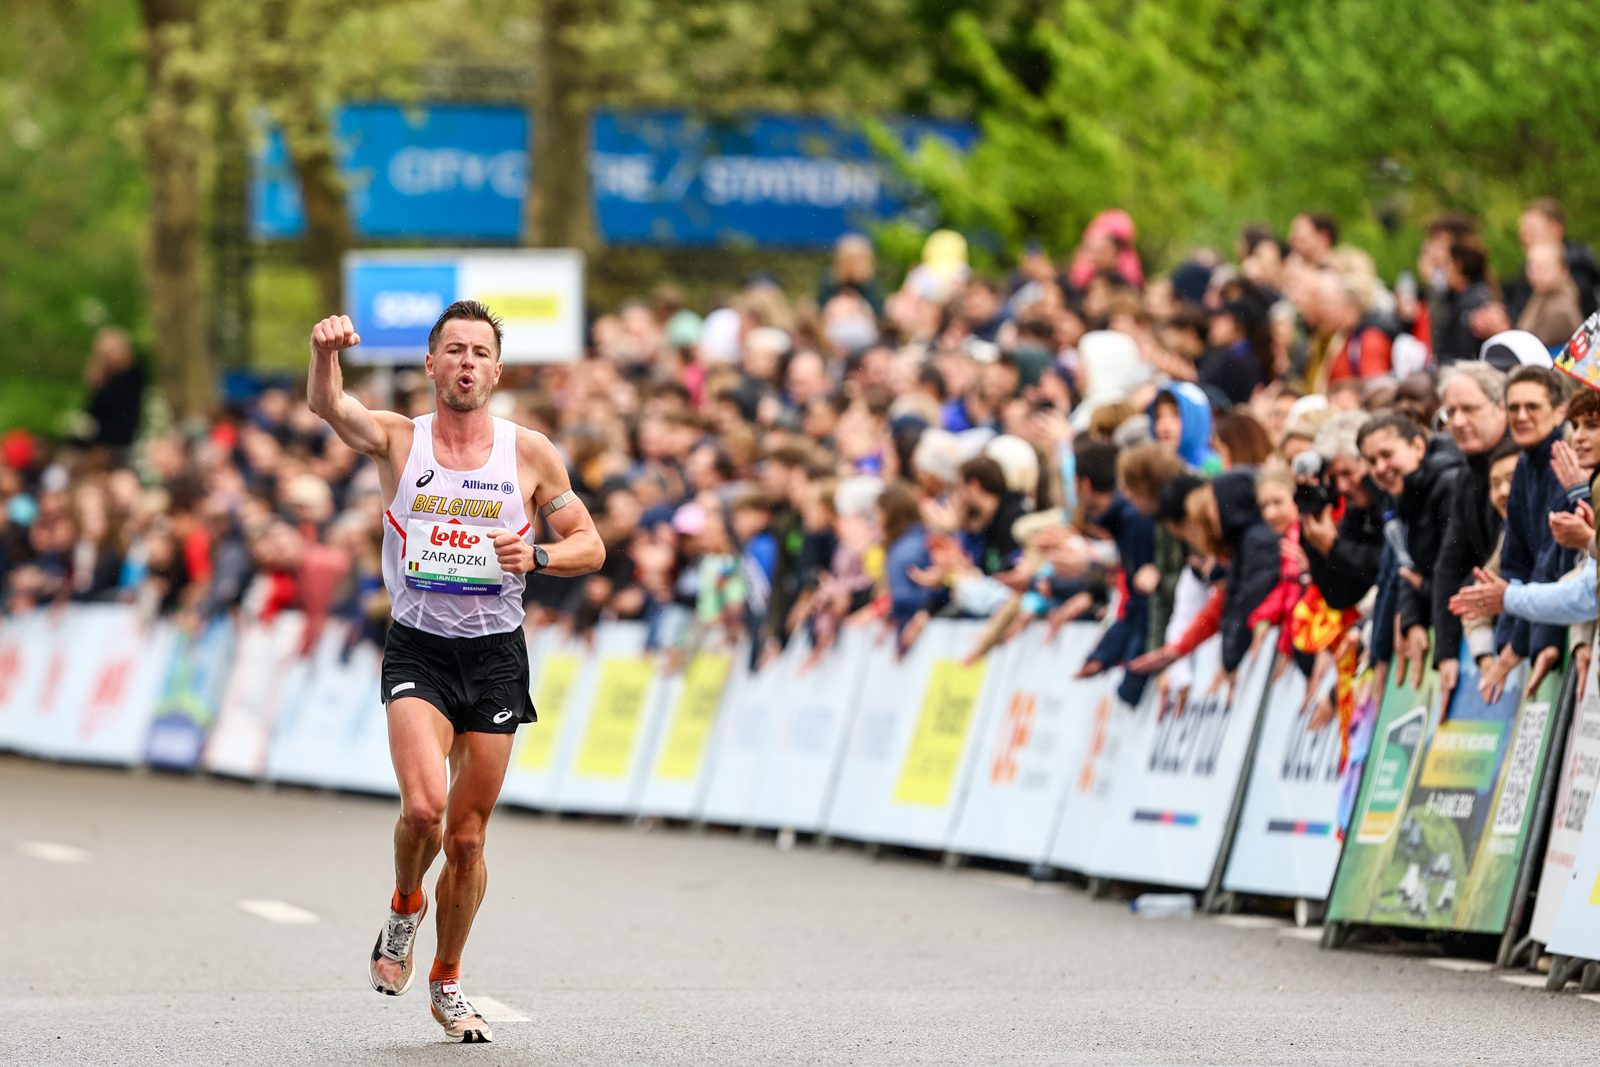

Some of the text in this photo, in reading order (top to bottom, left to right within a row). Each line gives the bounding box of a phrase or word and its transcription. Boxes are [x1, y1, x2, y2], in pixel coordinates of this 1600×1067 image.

[461, 479, 499, 491] Allianz
[412, 493, 503, 519] BELGIUM
[421, 549, 487, 567] ZARADZKI
[447, 567, 458, 575] 27
